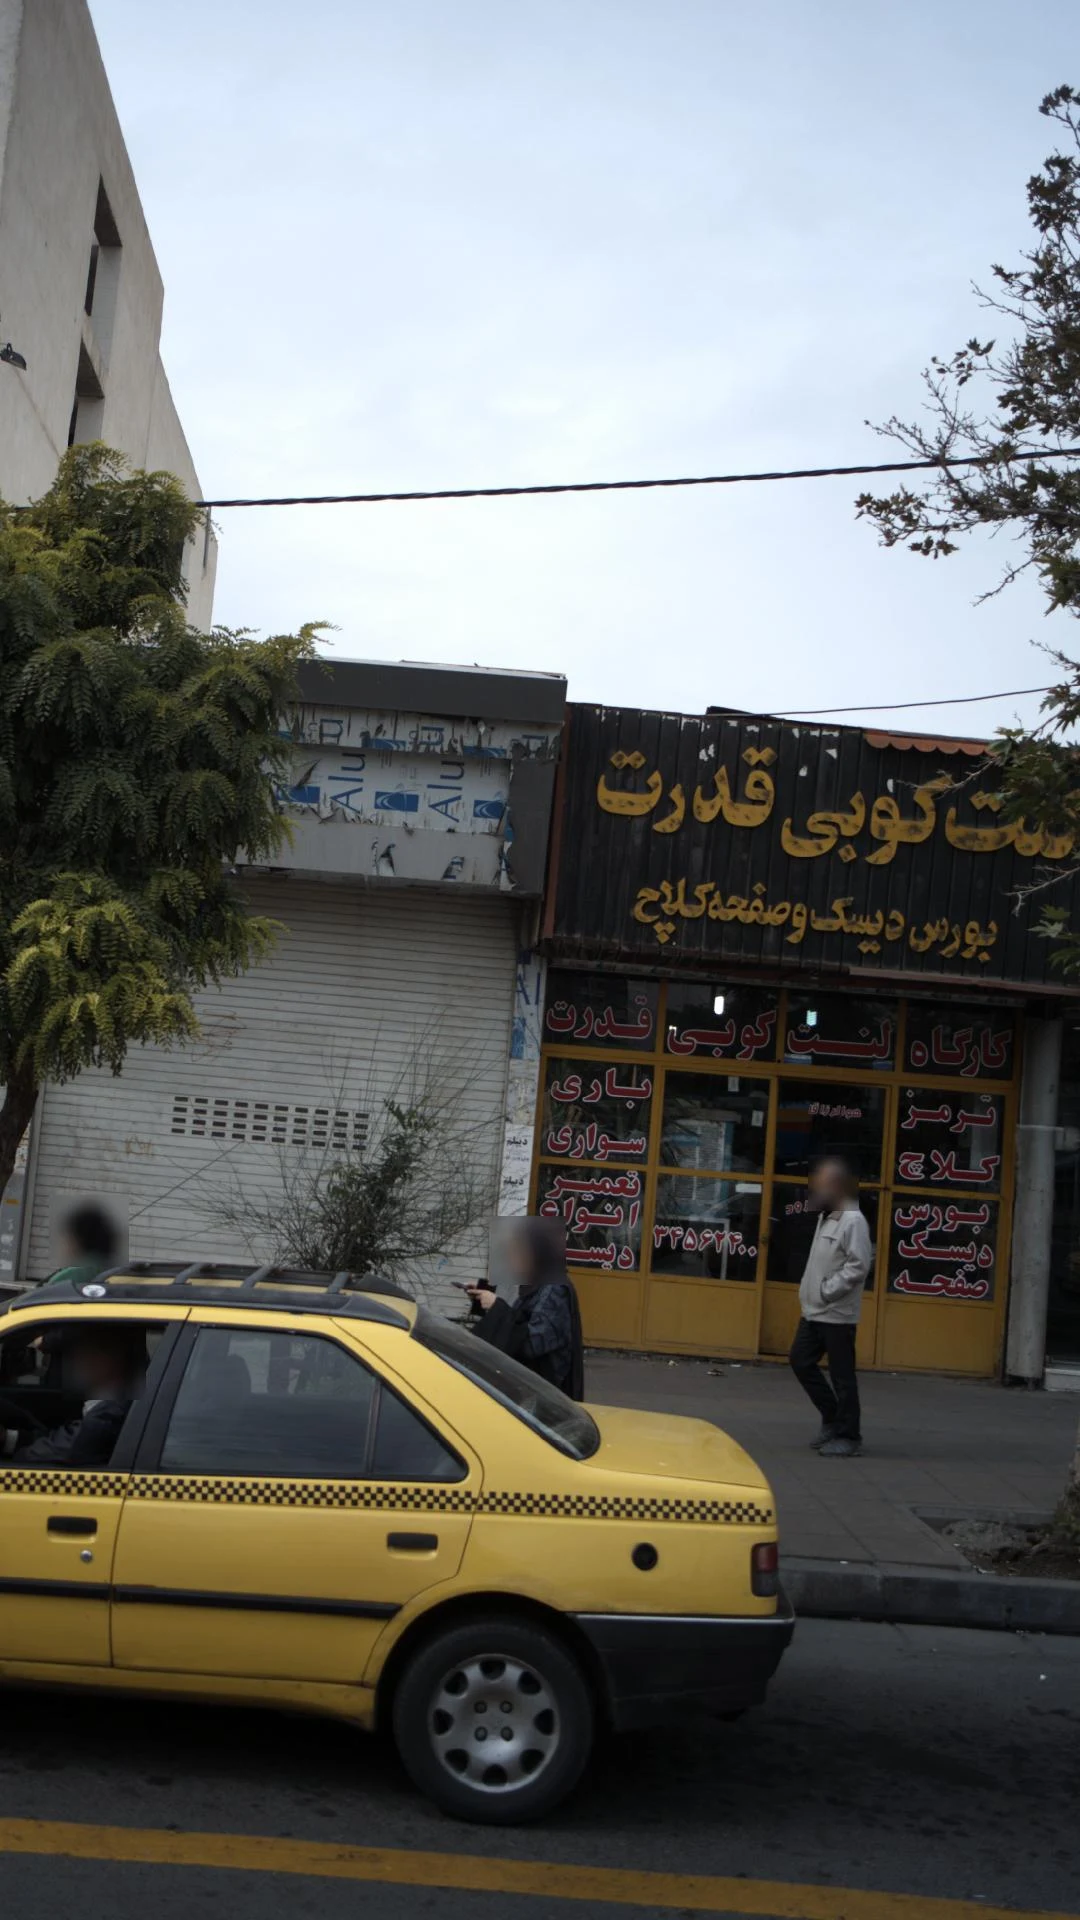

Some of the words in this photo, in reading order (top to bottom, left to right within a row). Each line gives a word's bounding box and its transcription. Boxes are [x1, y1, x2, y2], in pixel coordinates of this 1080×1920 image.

[597, 746, 777, 834] قدرت
[781, 774, 955, 865] کوبی
[631, 877, 715, 943] کلاچ
[810, 896, 905, 954] دیسک
[909, 917, 998, 964] بورس
[546, 995, 653, 1039] قدرت
[666, 1009, 777, 1060] کوبی
[787, 1019, 893, 1059] لنت
[910, 1026, 1012, 1077] کارگاه
[550, 1067, 653, 1110] باری
[901, 1089, 996, 1133] ترمز
[546, 1122, 647, 1160] سواری
[545, 1170, 641, 1200] تعمیر
[898, 1150, 1000, 1183] کلاچ
[895, 1202, 989, 1234] بورس
[565, 1237, 636, 1271] دیس
[898, 1231, 994, 1272] دیسک
[895, 1266, 989, 1298] صفحه
